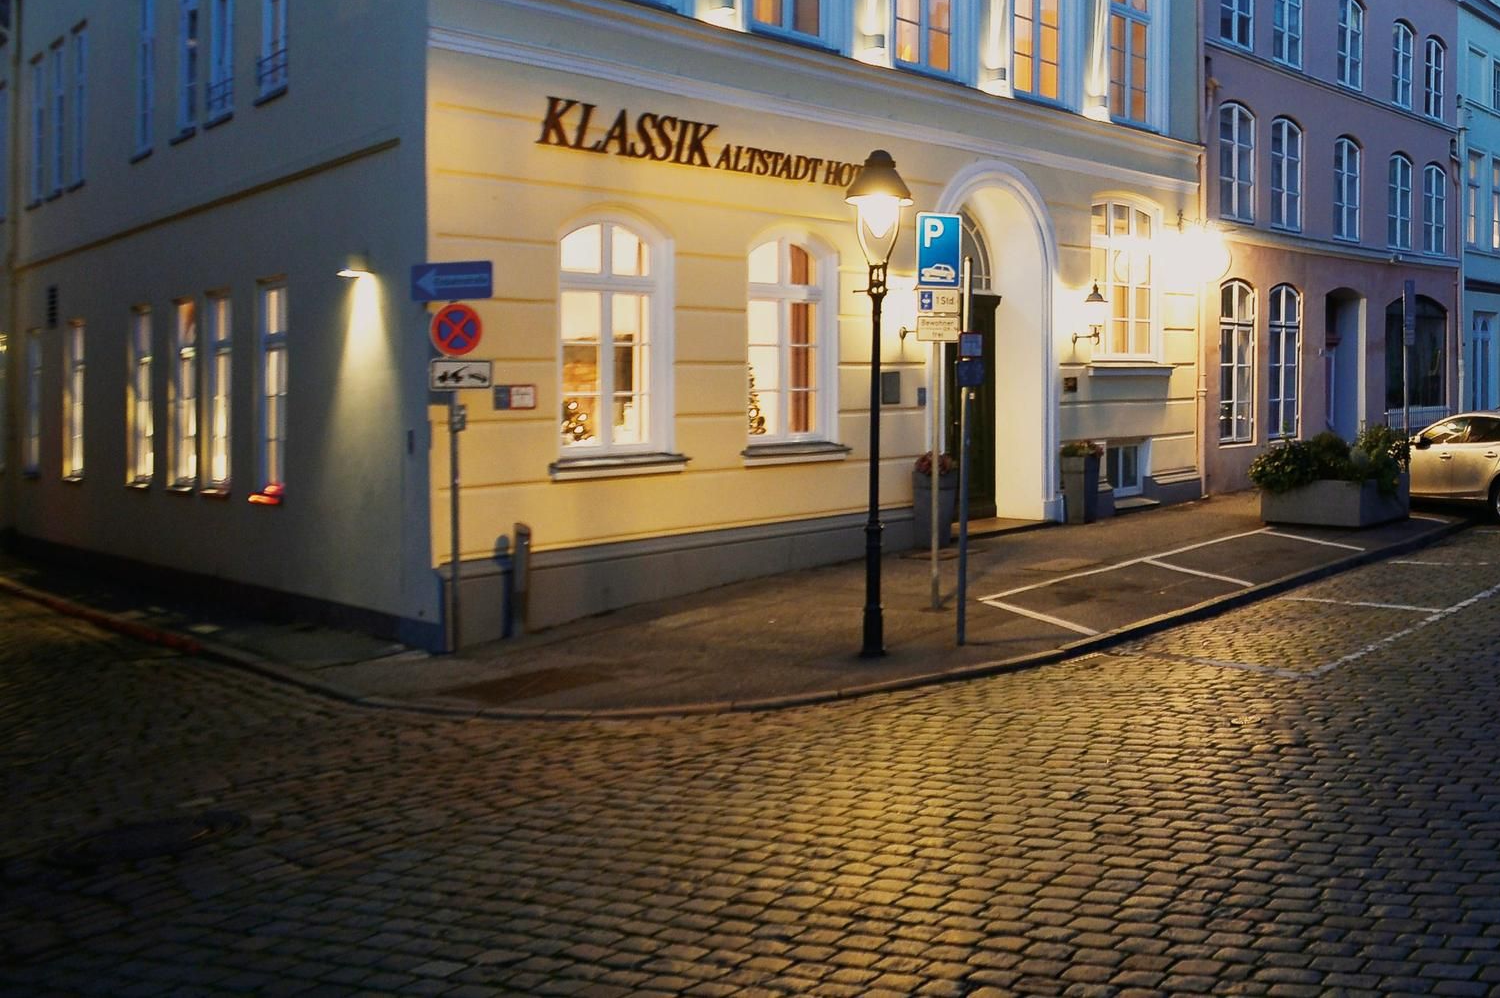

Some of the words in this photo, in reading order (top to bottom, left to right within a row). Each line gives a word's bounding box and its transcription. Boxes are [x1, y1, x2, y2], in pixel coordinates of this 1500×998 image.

[536, 96, 719, 169] KLASSIK
[714, 143, 823, 183] ALTSTADT
[822, 160, 866, 188] HOT
[924, 217, 945, 248] P
